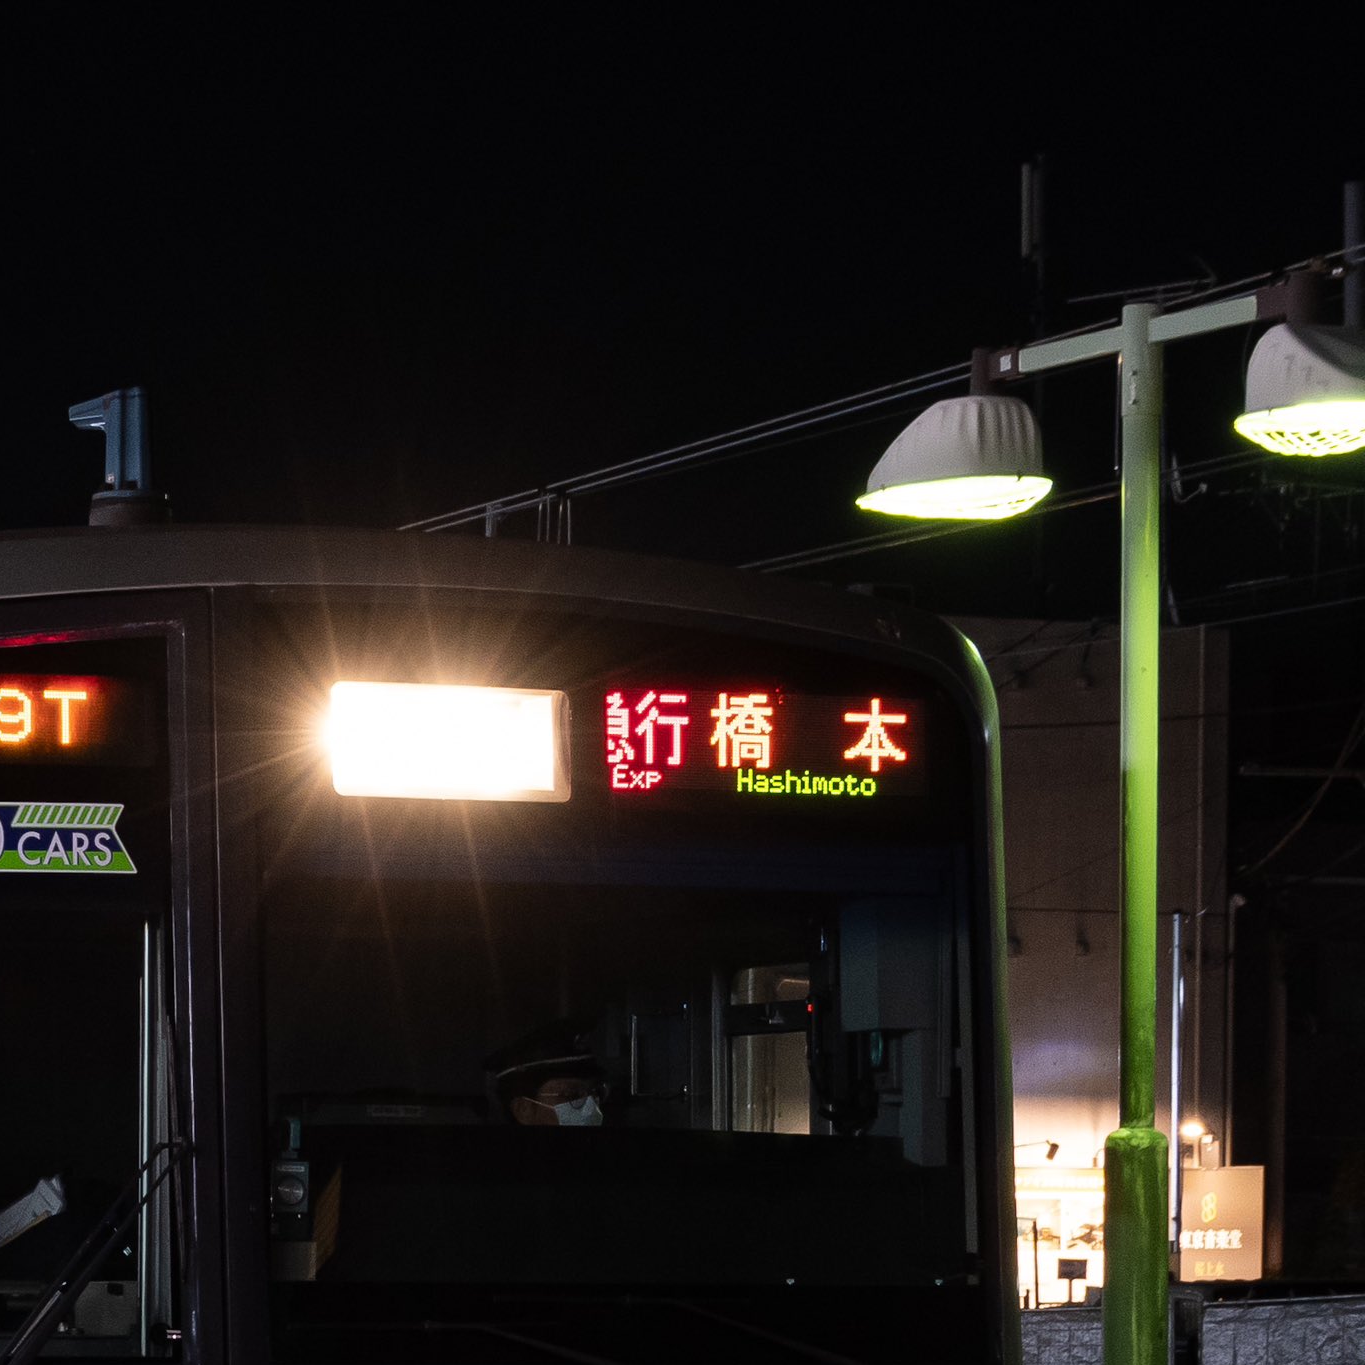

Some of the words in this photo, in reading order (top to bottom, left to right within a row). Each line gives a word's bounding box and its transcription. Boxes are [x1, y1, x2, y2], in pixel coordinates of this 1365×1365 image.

[612, 764, 662, 789] Exp
[736, 769, 877, 796] Hashimoto
[17, 831, 113, 867] CARS
